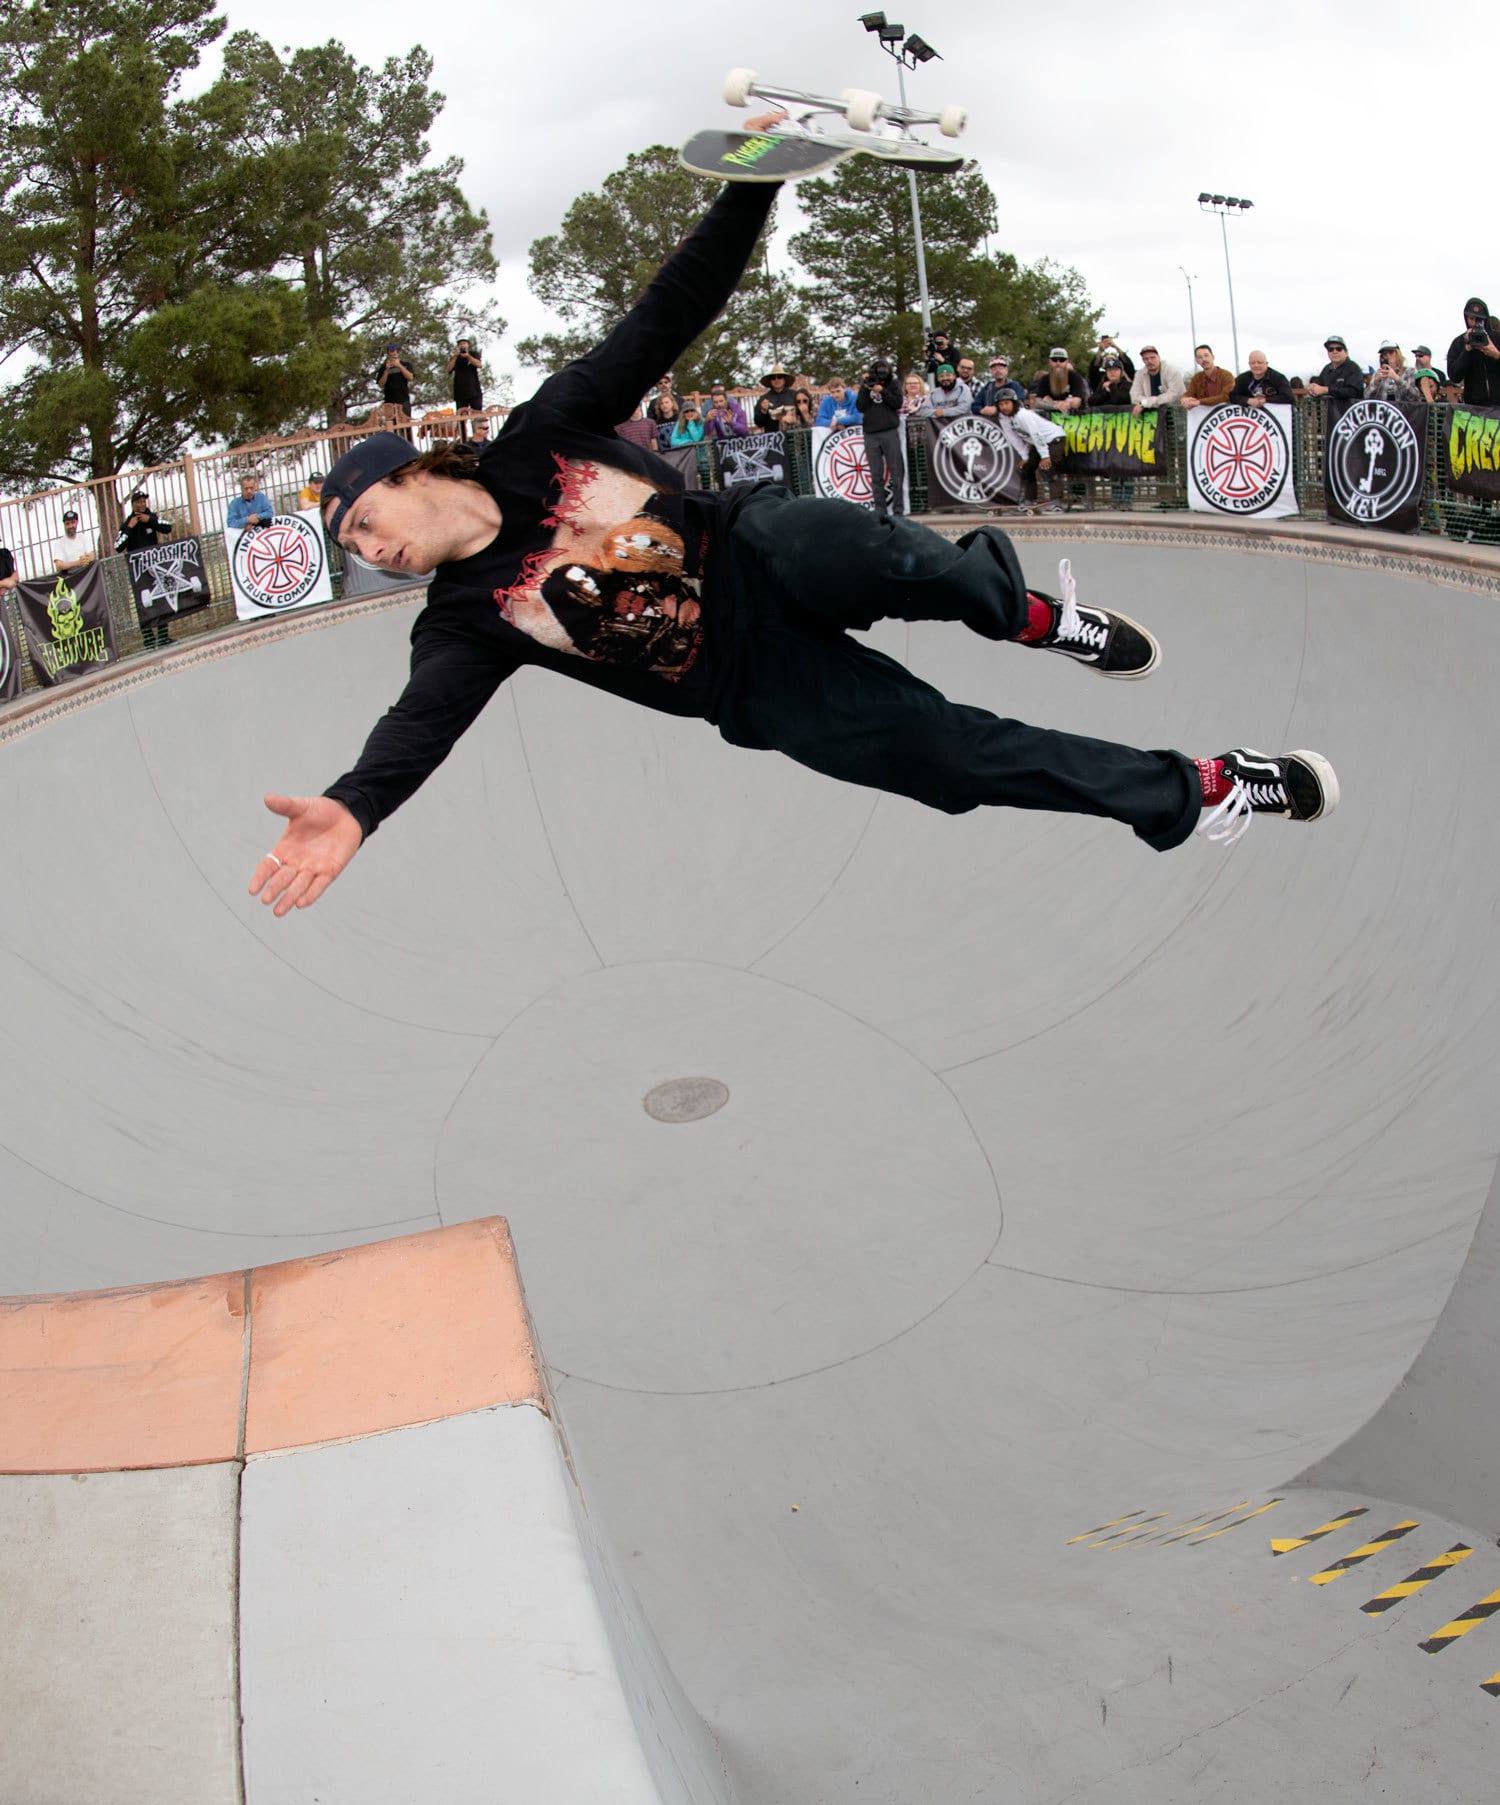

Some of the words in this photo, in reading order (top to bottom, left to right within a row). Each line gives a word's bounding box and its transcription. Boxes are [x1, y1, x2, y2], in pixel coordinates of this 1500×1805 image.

[941, 420, 1009, 452] SKELETON
[1201, 407, 1278, 440] INDEPENDENT
[1337, 403, 1414, 450] SKELETON
[716, 431, 785, 465] THRASHER
[958, 484, 987, 499] KEY
[1198, 468, 1228, 506] TRUCK
[1232, 468, 1280, 508] COMPANY
[1346, 492, 1380, 517] KEY
[240, 517, 311, 552] INDENDENT
[129, 539, 199, 582] THRASHER
[242, 577, 273, 604] TRUCK
[277, 562, 317, 604] COMPANY
[37, 626, 108, 680] CREATURE
